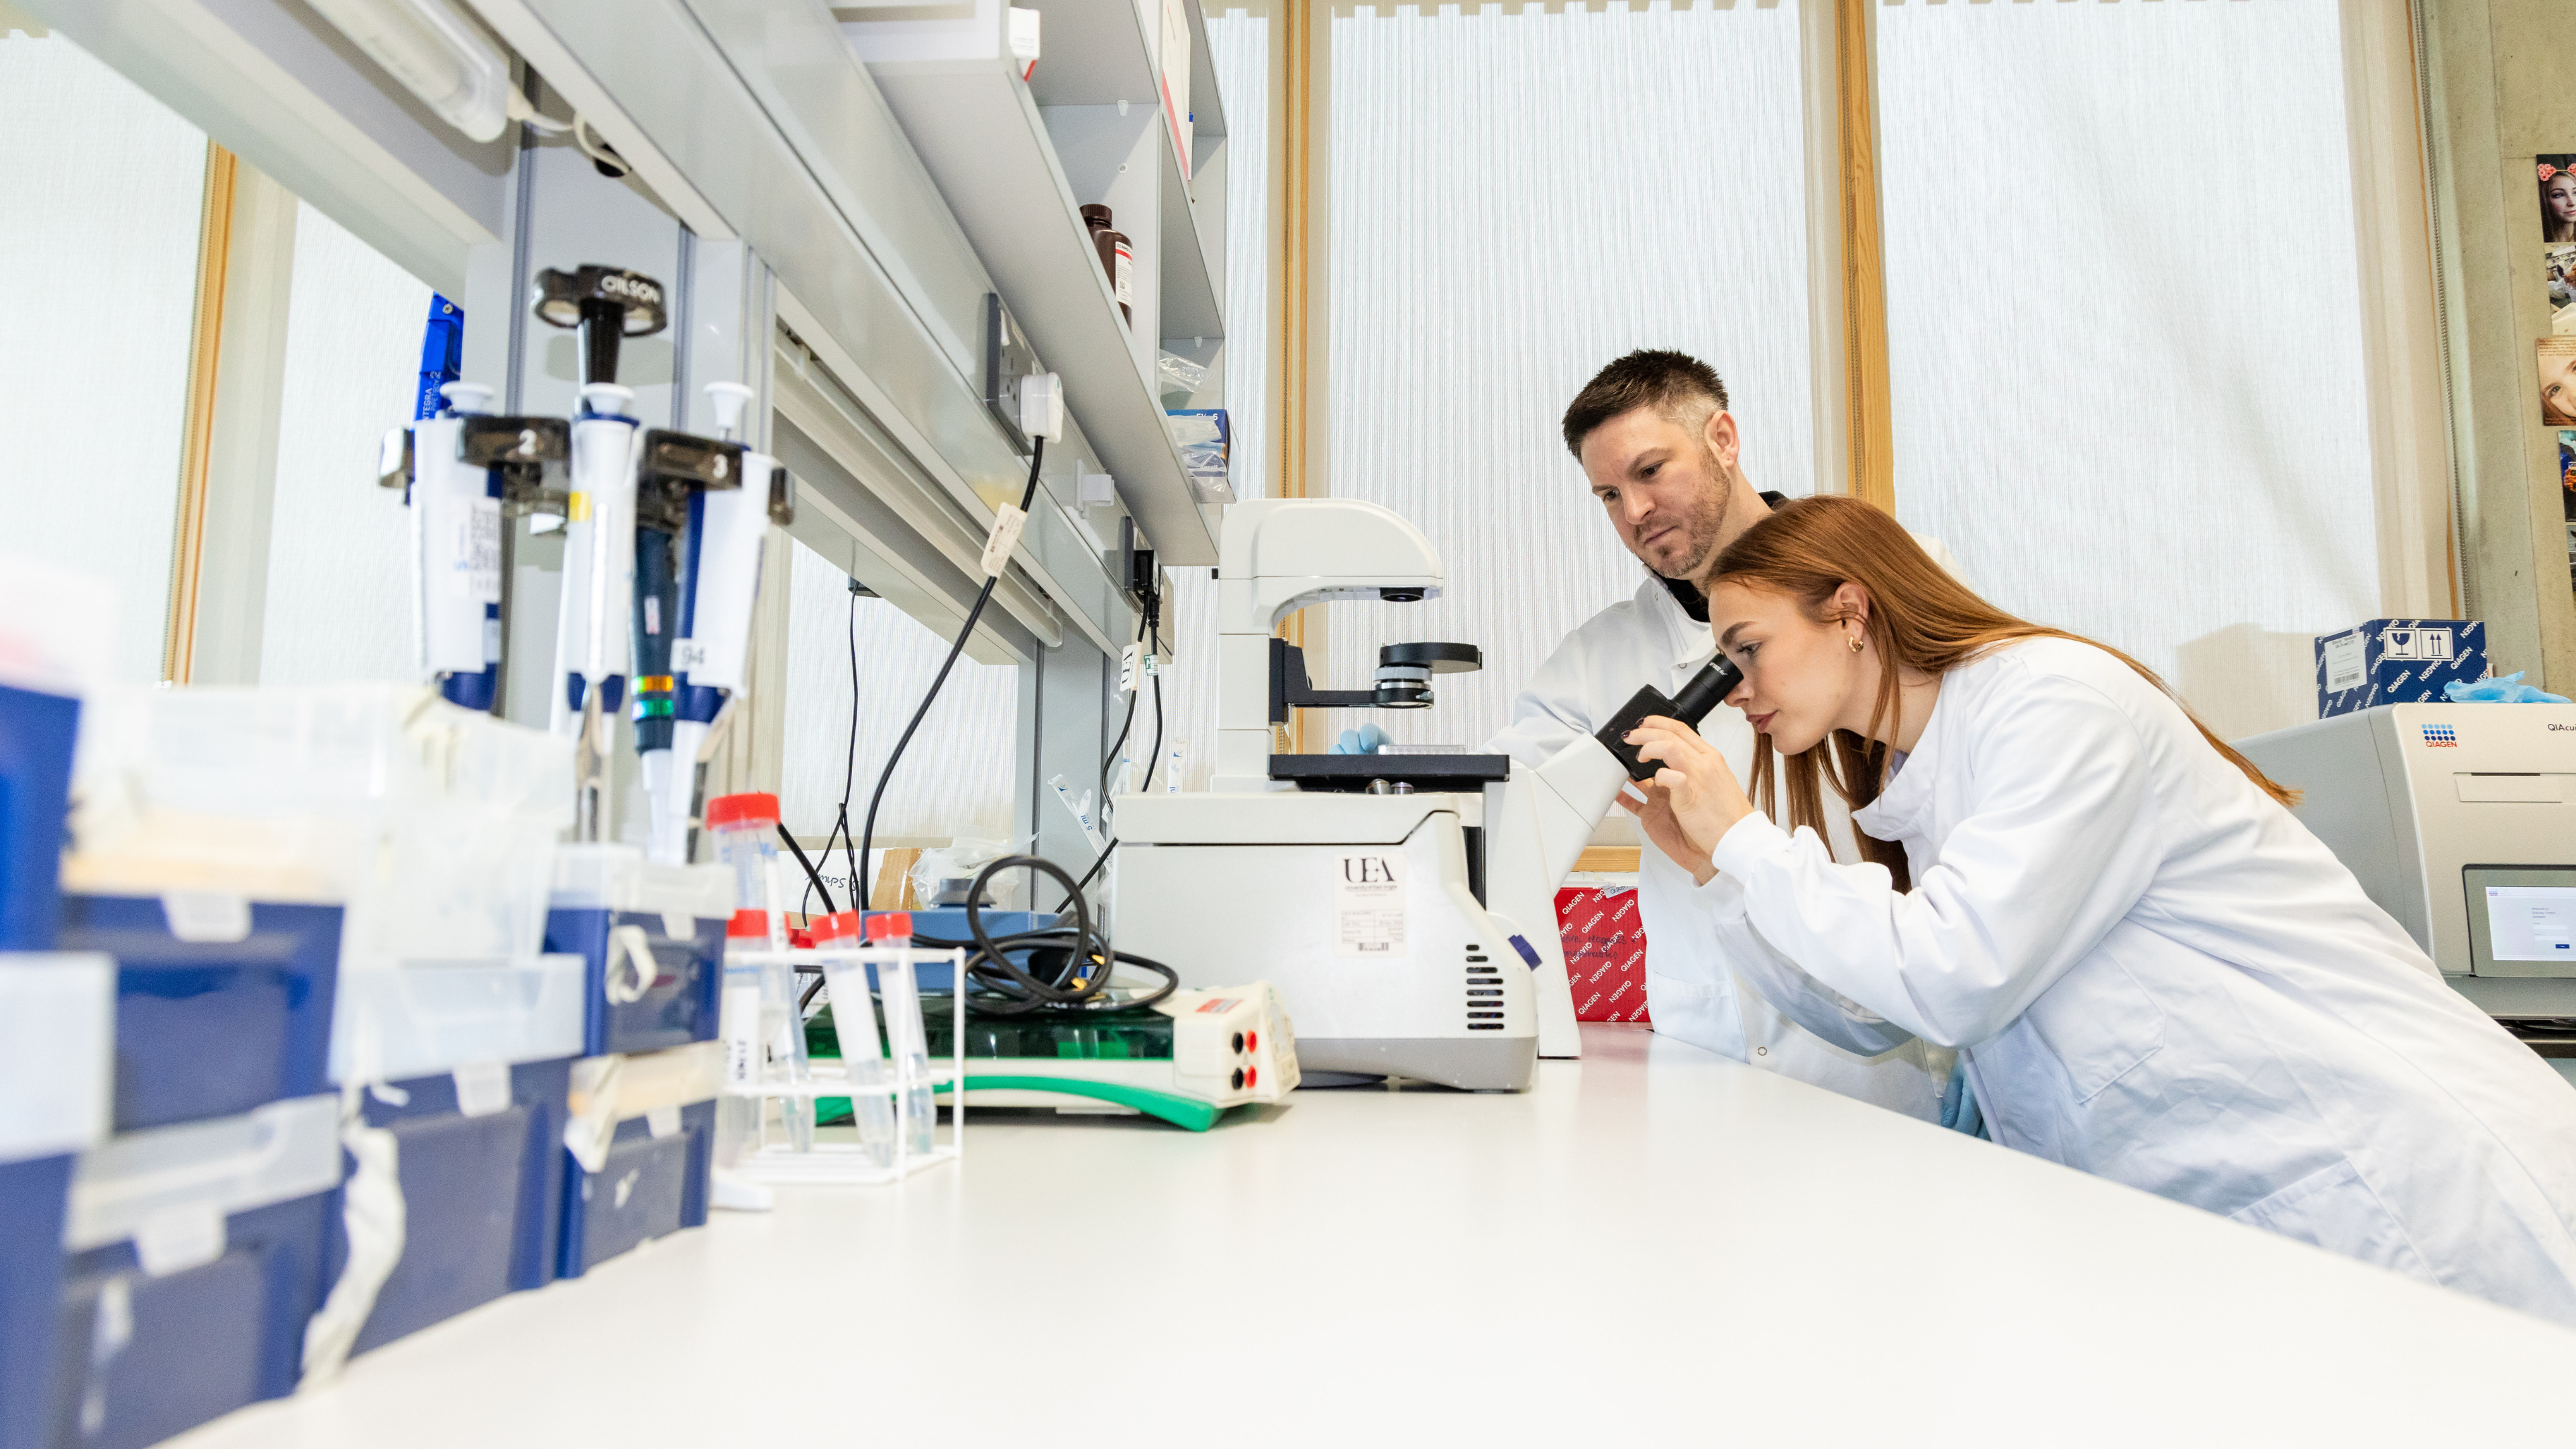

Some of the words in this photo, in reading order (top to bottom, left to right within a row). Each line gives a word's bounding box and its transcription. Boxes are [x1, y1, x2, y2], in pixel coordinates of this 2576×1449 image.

[430, 371, 441, 379] 2
[423, 388, 433, 420] NTEGRA
[519, 429, 536, 455] 2
[714, 453, 728, 478] 3
[2451, 647, 2473, 669] QIAGEN
[2387, 669, 2412, 693] QIAGEN
[2418, 660, 2442, 682] QIAGEN
[2365, 683, 2379, 708] QIAGEN
[2417, 689, 2432, 703] GEN
[1080, 814, 1089, 824] ml
[1344, 857, 1395, 882] UEA
[1562, 892, 1585, 914] QIAGEN
[1593, 890, 1605, 903] GEN
[1582, 911, 1604, 933] QIAGEN
[1612, 899, 1635, 922] QIAGEN
[1560, 923, 1573, 938] QIAG
[1601, 930, 1623, 953] QIAGEN
[1631, 926, 1645, 941] GEN
[1570, 942, 1592, 965] QIAGEN
[1621, 949, 1644, 972] QIAGEN
[1569, 973, 1582, 988] GEN
[1589, 961, 1612, 984] QIAGEN
[1578, 991, 1601, 1015] QIAGEN
[1609, 980, 1631, 1003] QIAGEN
[1607, 1011, 1621, 1022] GEN
